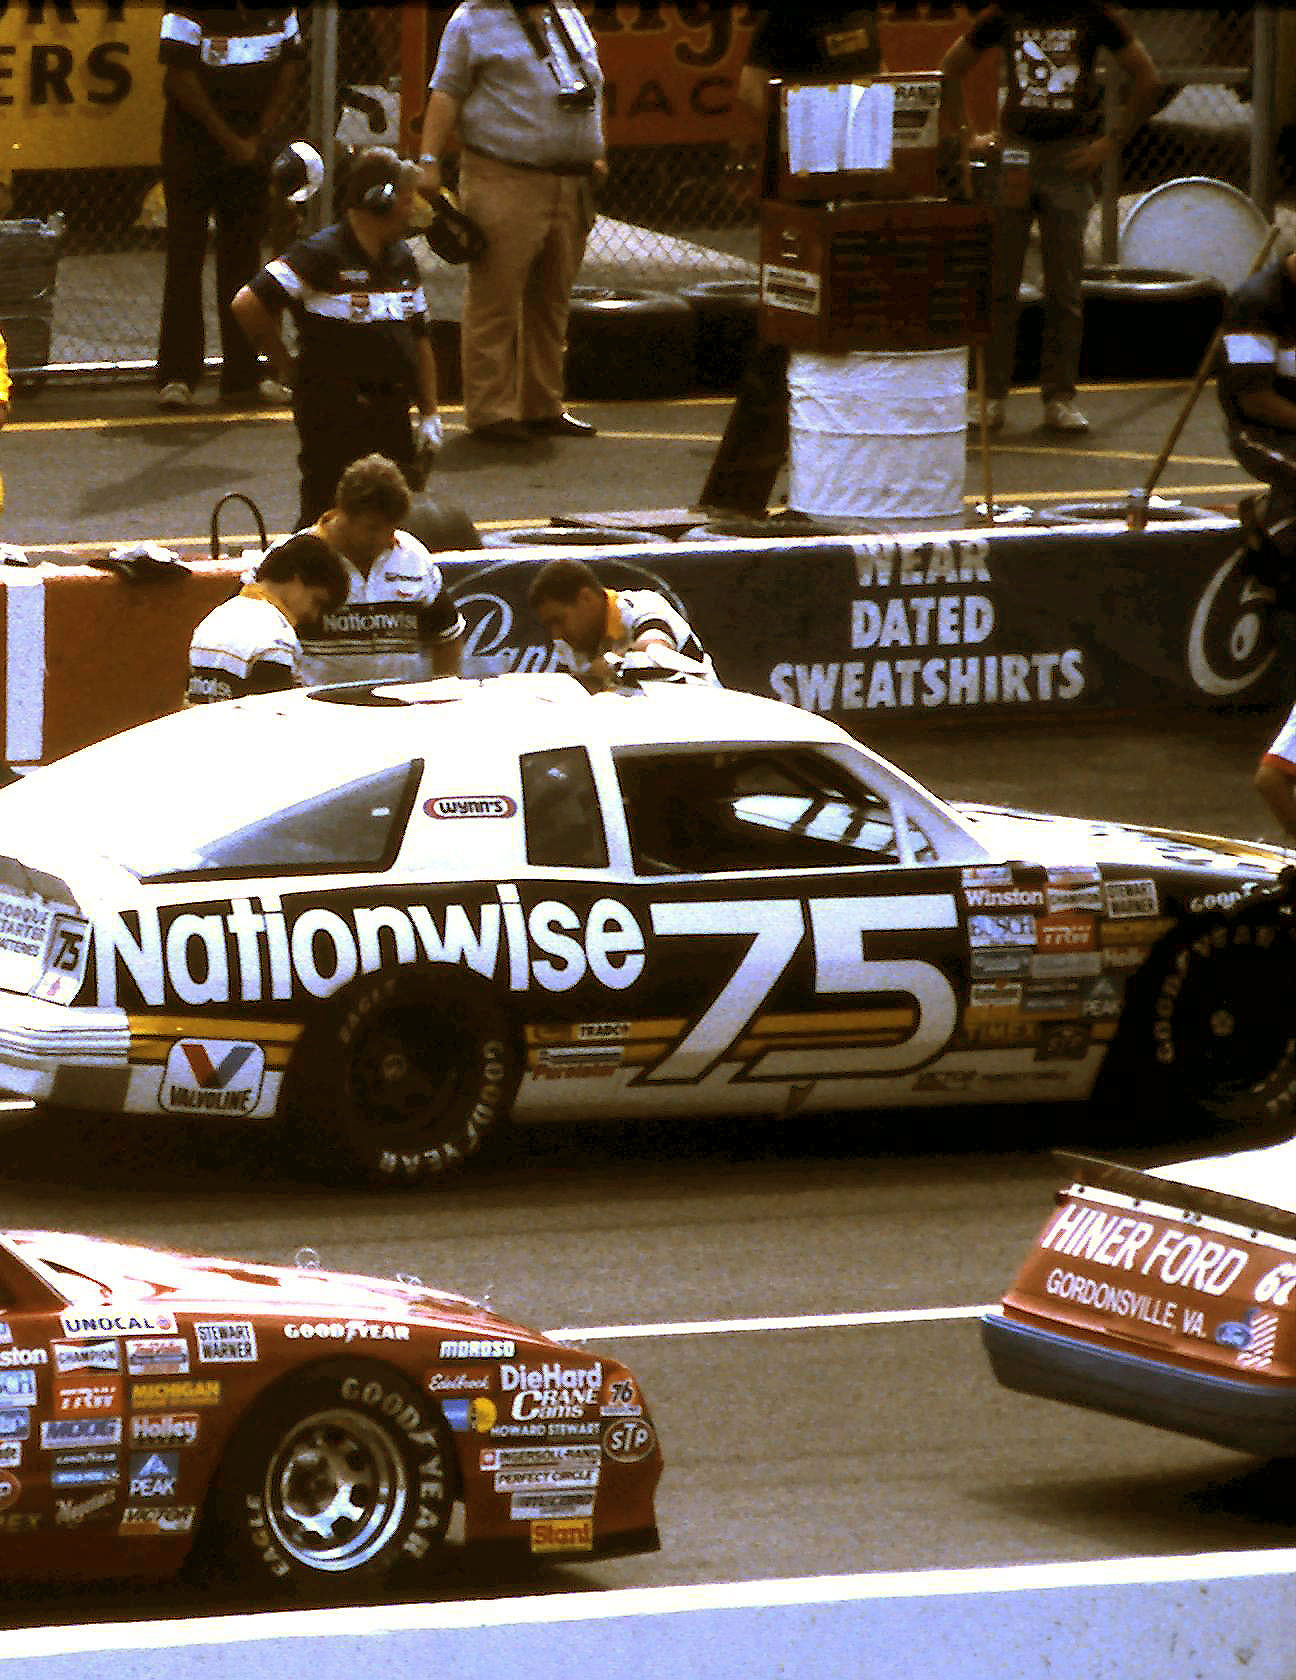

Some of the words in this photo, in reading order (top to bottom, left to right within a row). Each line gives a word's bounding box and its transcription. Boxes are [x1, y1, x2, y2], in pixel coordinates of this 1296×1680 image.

[850, 539, 992, 587] WEAR
[851, 596, 995, 649] DATED
[769, 649, 1087, 713] SWEATSHIRTS
[52, 929, 85, 971] 75
[92, 883, 646, 1008] Nationwise
[629, 893, 959, 1086] 75
[1041, 1203, 1155, 1271] HINER
[1141, 1228, 1249, 1297] FORD
[65, 1316, 154, 1333] UNOCAL
[197, 1326, 251, 1341] STEWART
[283, 1320, 411, 1343] GOODYEAR
[203, 1342, 252, 1359] WARNER
[500, 1361, 603, 1393] DieHard
[610, 1381, 633, 1403] 76
[610, 1423, 649, 1451] STP
[129, 1478, 176, 1496] PEAK
